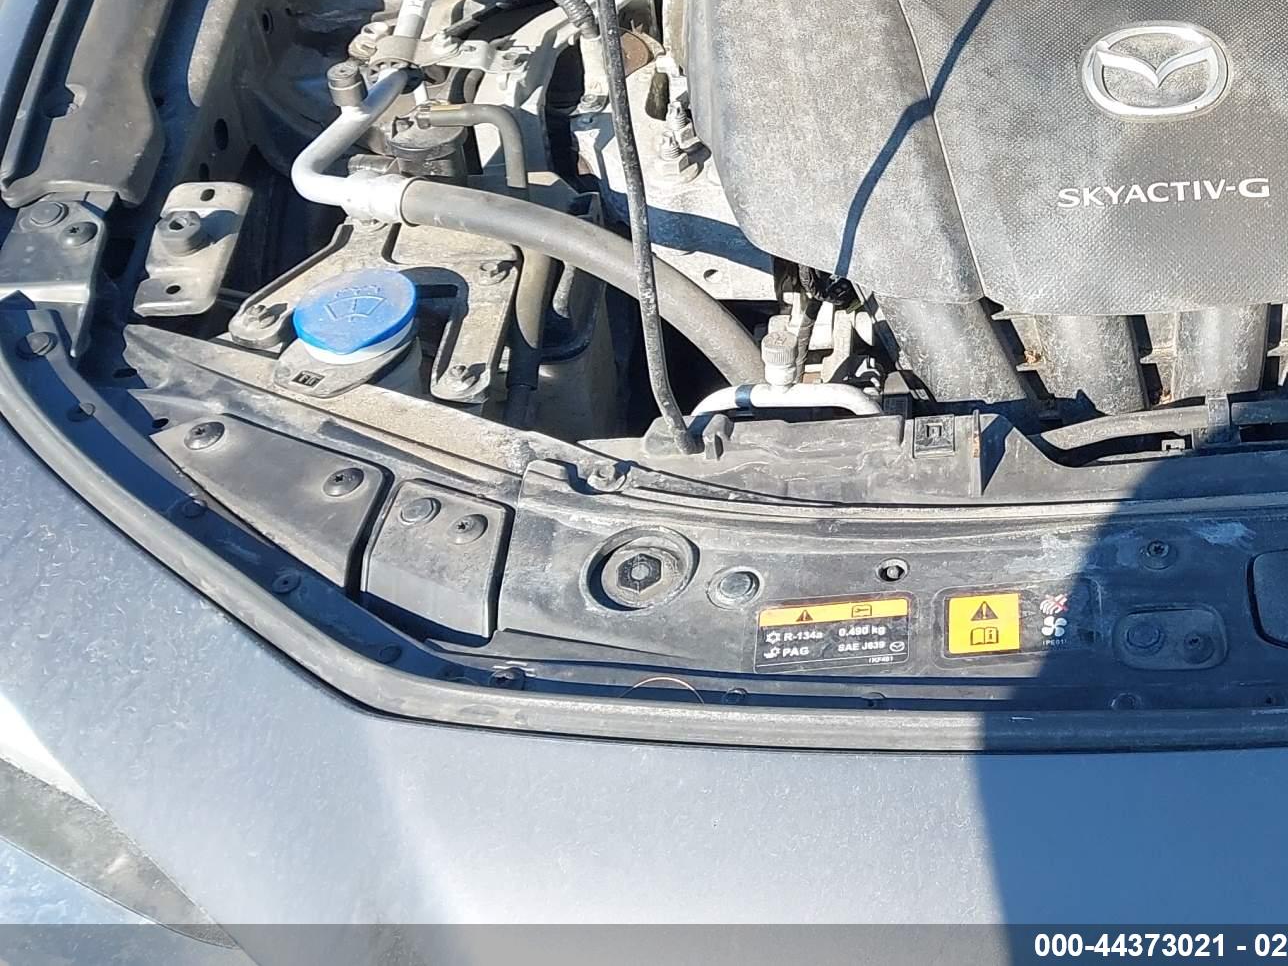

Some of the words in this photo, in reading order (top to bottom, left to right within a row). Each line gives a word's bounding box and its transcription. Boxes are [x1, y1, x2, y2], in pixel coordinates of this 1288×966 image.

[1057, 177, 1270, 208] SKYACTIV-G
[783, 631, 823, 641] R-134a
[871, 625, 886, 636] kg
[782, 646, 810, 657] PAG
[837, 643, 860, 652] SAE
[861, 641, 886, 651] J639
